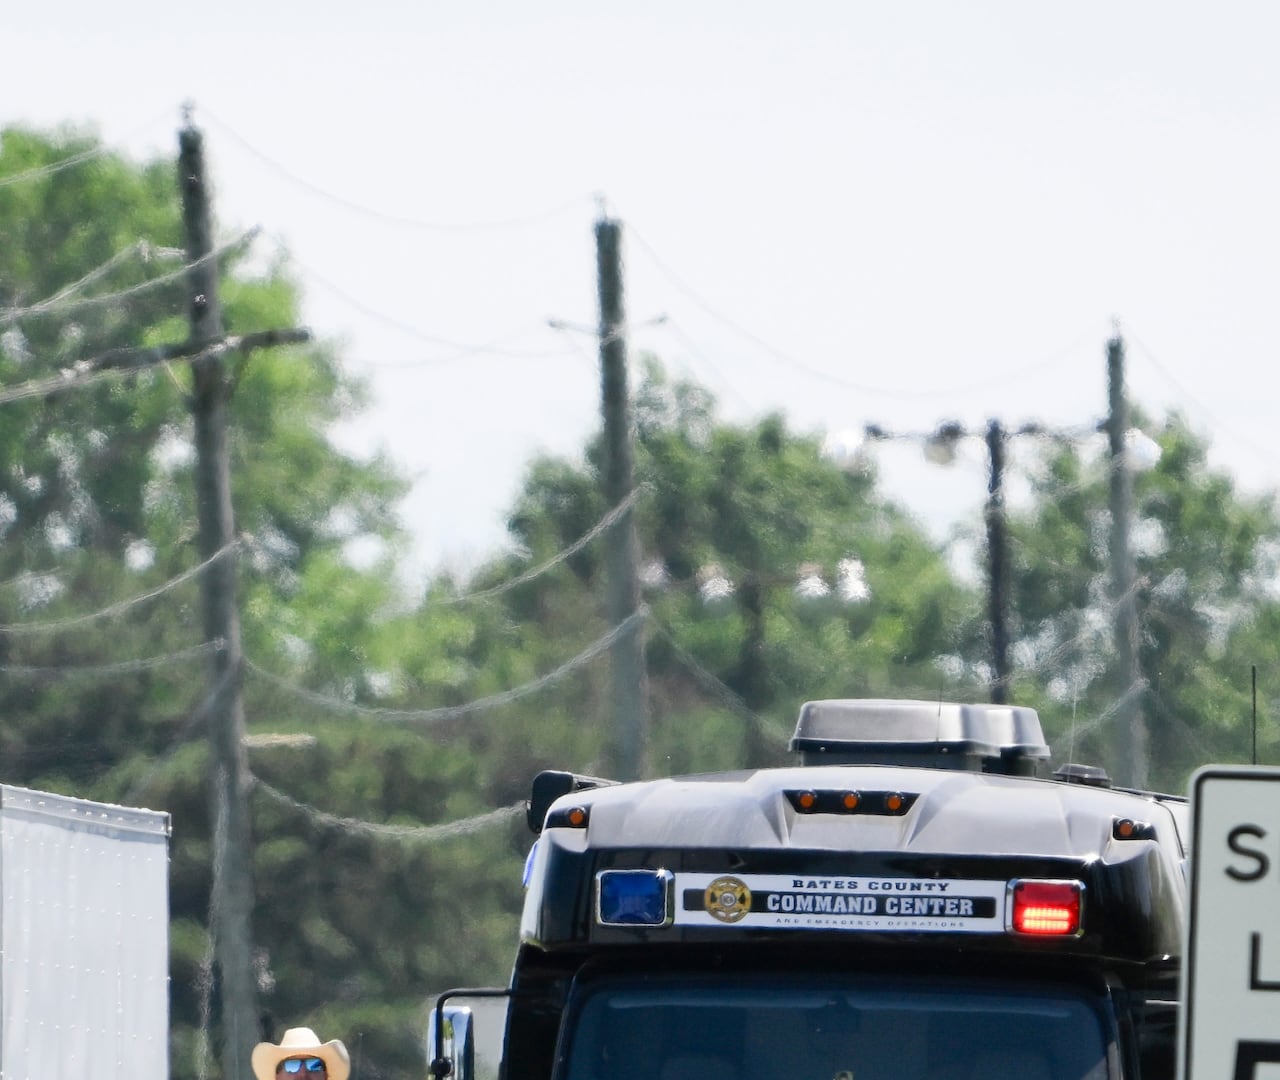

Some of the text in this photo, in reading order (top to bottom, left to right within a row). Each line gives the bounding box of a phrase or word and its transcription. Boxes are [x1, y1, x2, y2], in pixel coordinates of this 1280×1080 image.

[792, 879, 950, 892] BATES COUNTY
[767, 893, 974, 916] COMMAND CENTER
